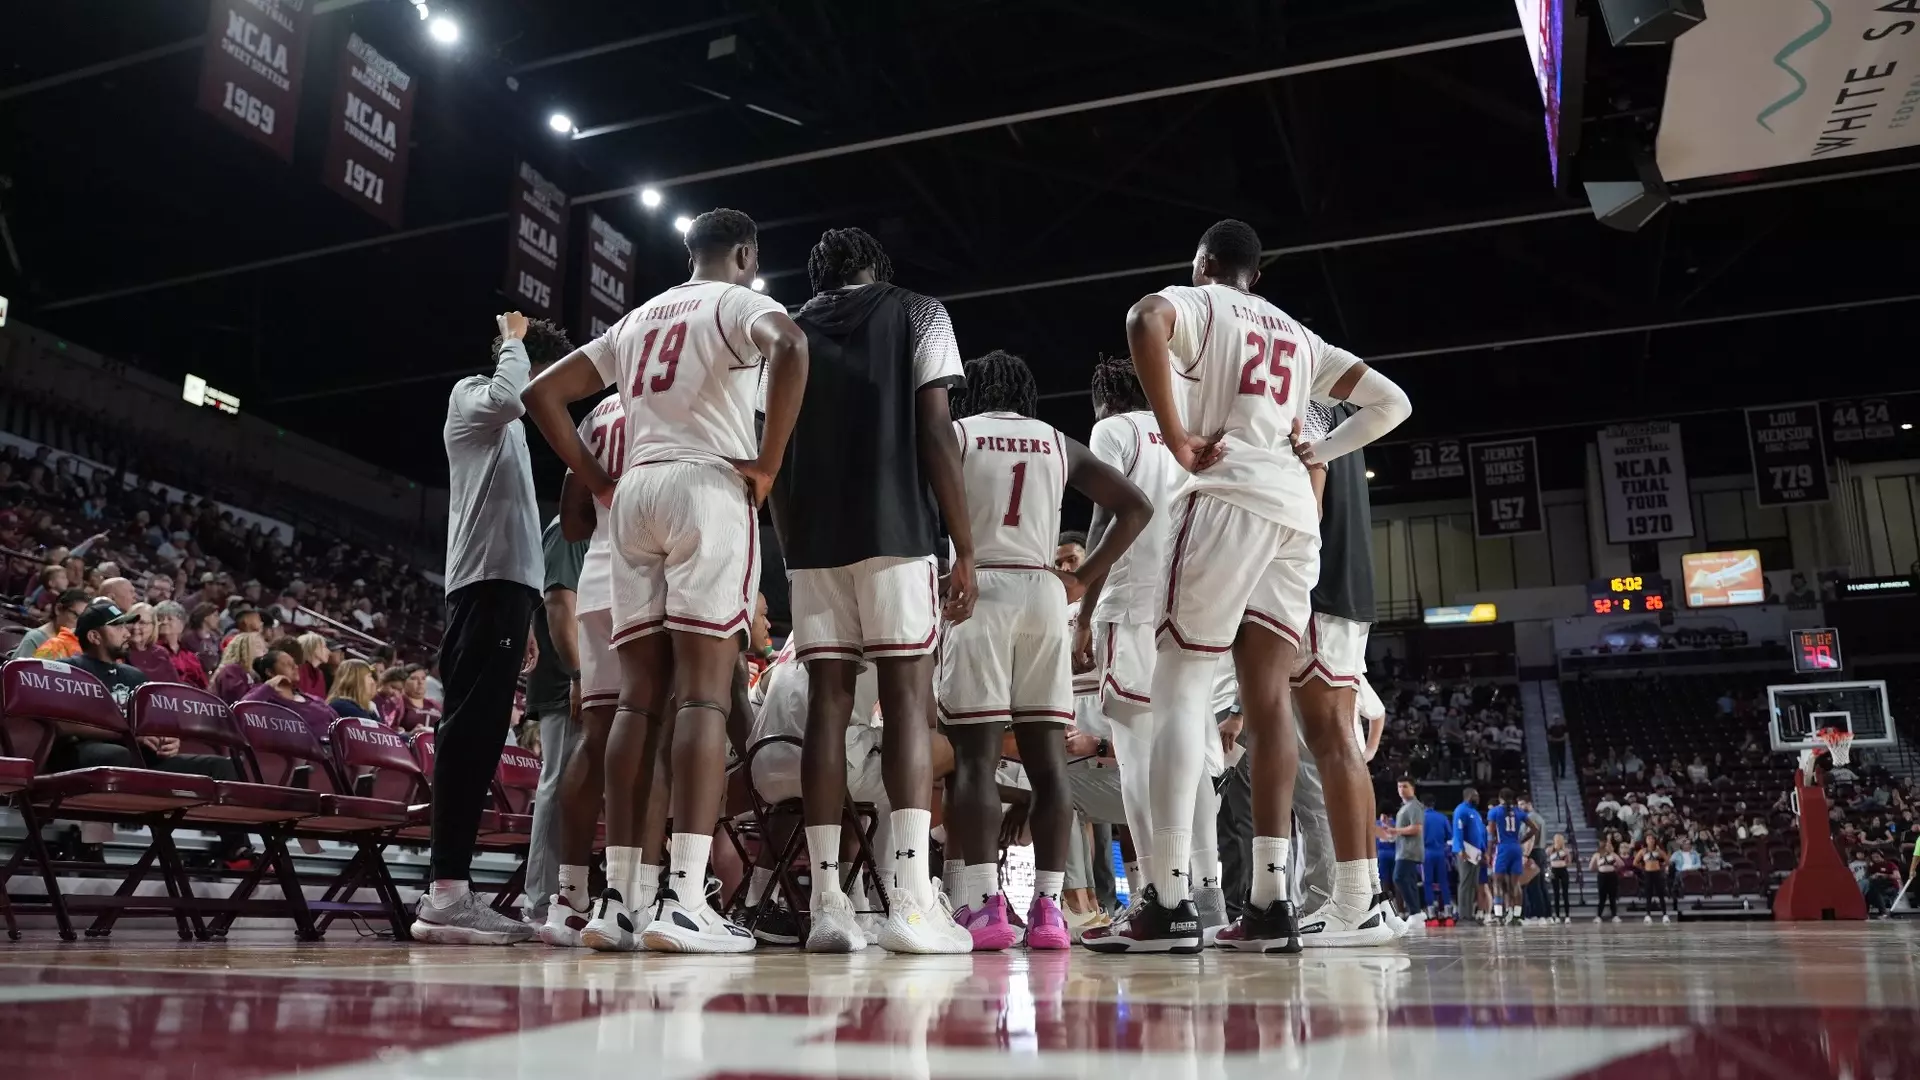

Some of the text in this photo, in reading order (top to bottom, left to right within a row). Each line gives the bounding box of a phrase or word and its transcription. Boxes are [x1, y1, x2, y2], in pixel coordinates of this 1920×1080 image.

[226, 9, 288, 75] NCAA
[221, 37, 291, 92] SWEET SIXTEEN
[223, 81, 276, 135] 1969
[1811, 61, 1898, 156] WHITE
[344, 92, 397, 149] NCAA
[343, 158, 384, 205] 1971
[518, 213, 558, 260] NCAA
[518, 270, 551, 308] 1975
[590, 262, 625, 305] NCAA
[632, 322, 688, 398] 19
[1238, 331, 1297, 405] 25
[1768, 411, 1796, 427] LOU
[1832, 407, 1859, 427] 44
[1864, 403, 1890, 424] 24
[975, 436, 1051, 455] PICKENS
[1757, 426, 1814, 443] HENSON
[591, 416, 626, 480] 20
[1413, 447, 1433, 466] 31
[1439, 445, 1461, 464] 22
[1480, 444, 1525, 462] JERRY
[1614, 443, 1671, 455] BASKETBALL
[1614, 457, 1673, 478] NCAA
[1768, 464, 1814, 491] 779
[1002, 461, 1028, 527] 1
[1621, 478, 1670, 494] FINAL
[1489, 496, 1525, 521] 157
[1626, 494, 1669, 510] FOUR
[1626, 514, 1673, 535] 1970
[1610, 576, 1643, 592] 16:02
[1593, 598, 1612, 614] 52
[1645, 595, 1664, 610] 26
[17, 671, 104, 699] NM STATE
[149, 693, 228, 718] NM STATE
[244, 712, 308, 735] NM STATE
[347, 727, 402, 748] NM STATE
[501, 753, 542, 770] NM STATE
[1504, 815, 1517, 832] 11
